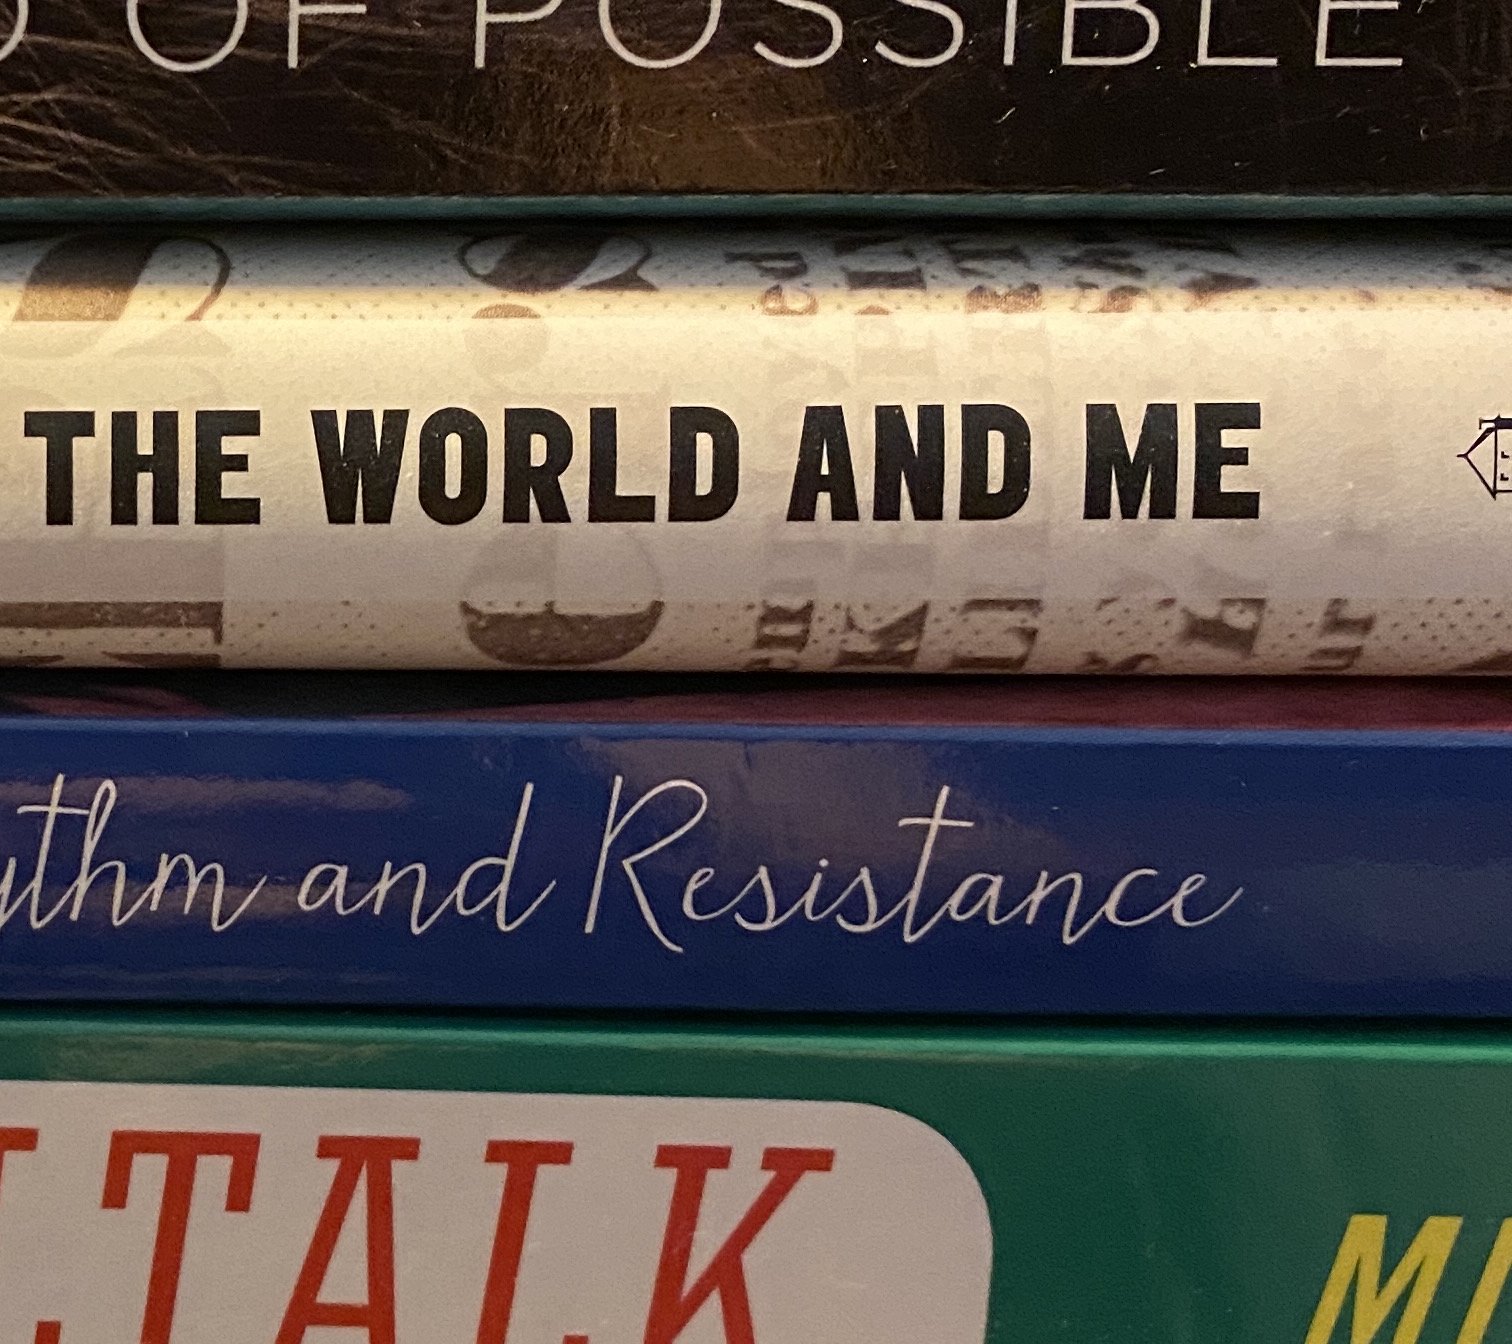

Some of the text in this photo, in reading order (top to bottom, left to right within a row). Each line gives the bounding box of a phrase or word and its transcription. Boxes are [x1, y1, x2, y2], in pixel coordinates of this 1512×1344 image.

[23, 409, 261, 526] THE
[310, 406, 740, 526] WORLD
[785, 403, 1032, 523] AND
[1082, 402, 1261, 521] ME
[296, 781, 557, 936] and
[584, 774, 1244, 953] Resistance
